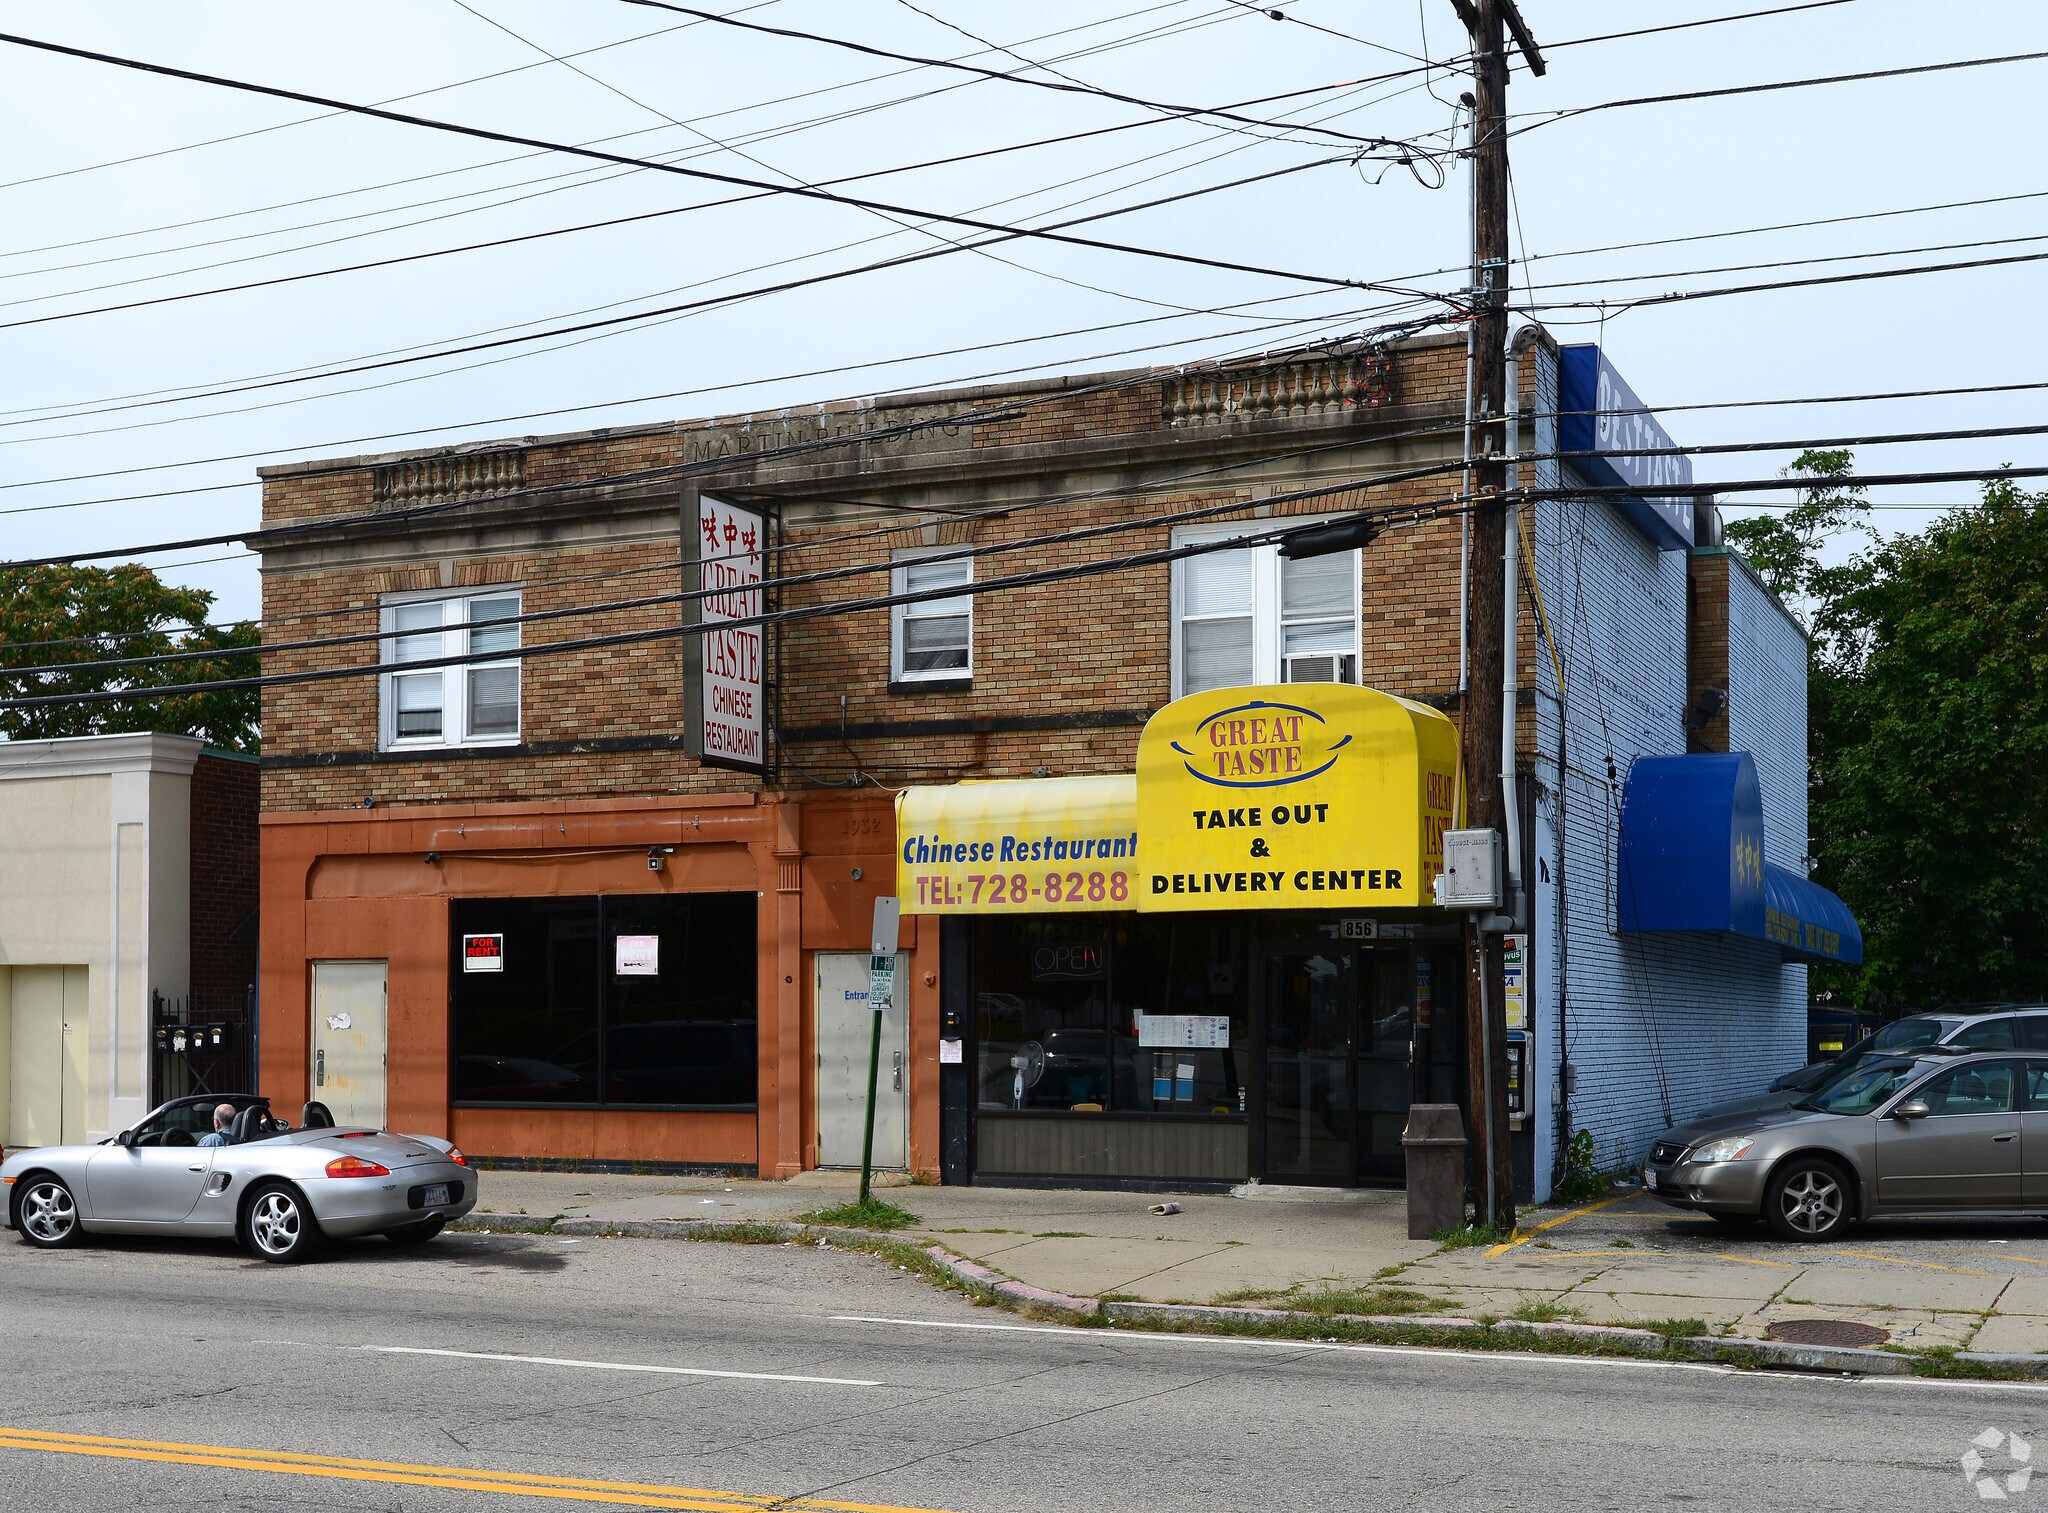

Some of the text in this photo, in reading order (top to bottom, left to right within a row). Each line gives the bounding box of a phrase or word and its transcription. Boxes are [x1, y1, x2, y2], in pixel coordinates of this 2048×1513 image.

[694, 430, 803, 462] MARTIN
[702, 560, 760, 618] GREAT
[703, 621, 760, 684] TASTE
[712, 685, 752, 719] CHINESE
[705, 721, 759, 757] RESTAURANT
[1209, 716, 1304, 748] GREAT
[1213, 746, 1303, 777] TASTE
[1193, 804, 1329, 830] TAKE OUT
[903, 832, 1137, 864] Chinese Restaurant
[1250, 838, 1271, 858] &
[1152, 869, 1403, 894] DELIVERY CENTER
[472, 938, 494, 947] FOR
[1345, 921, 1372, 937] 856
[467, 947, 499, 957] RENT
[1035, 946, 1103, 970] OPEN
